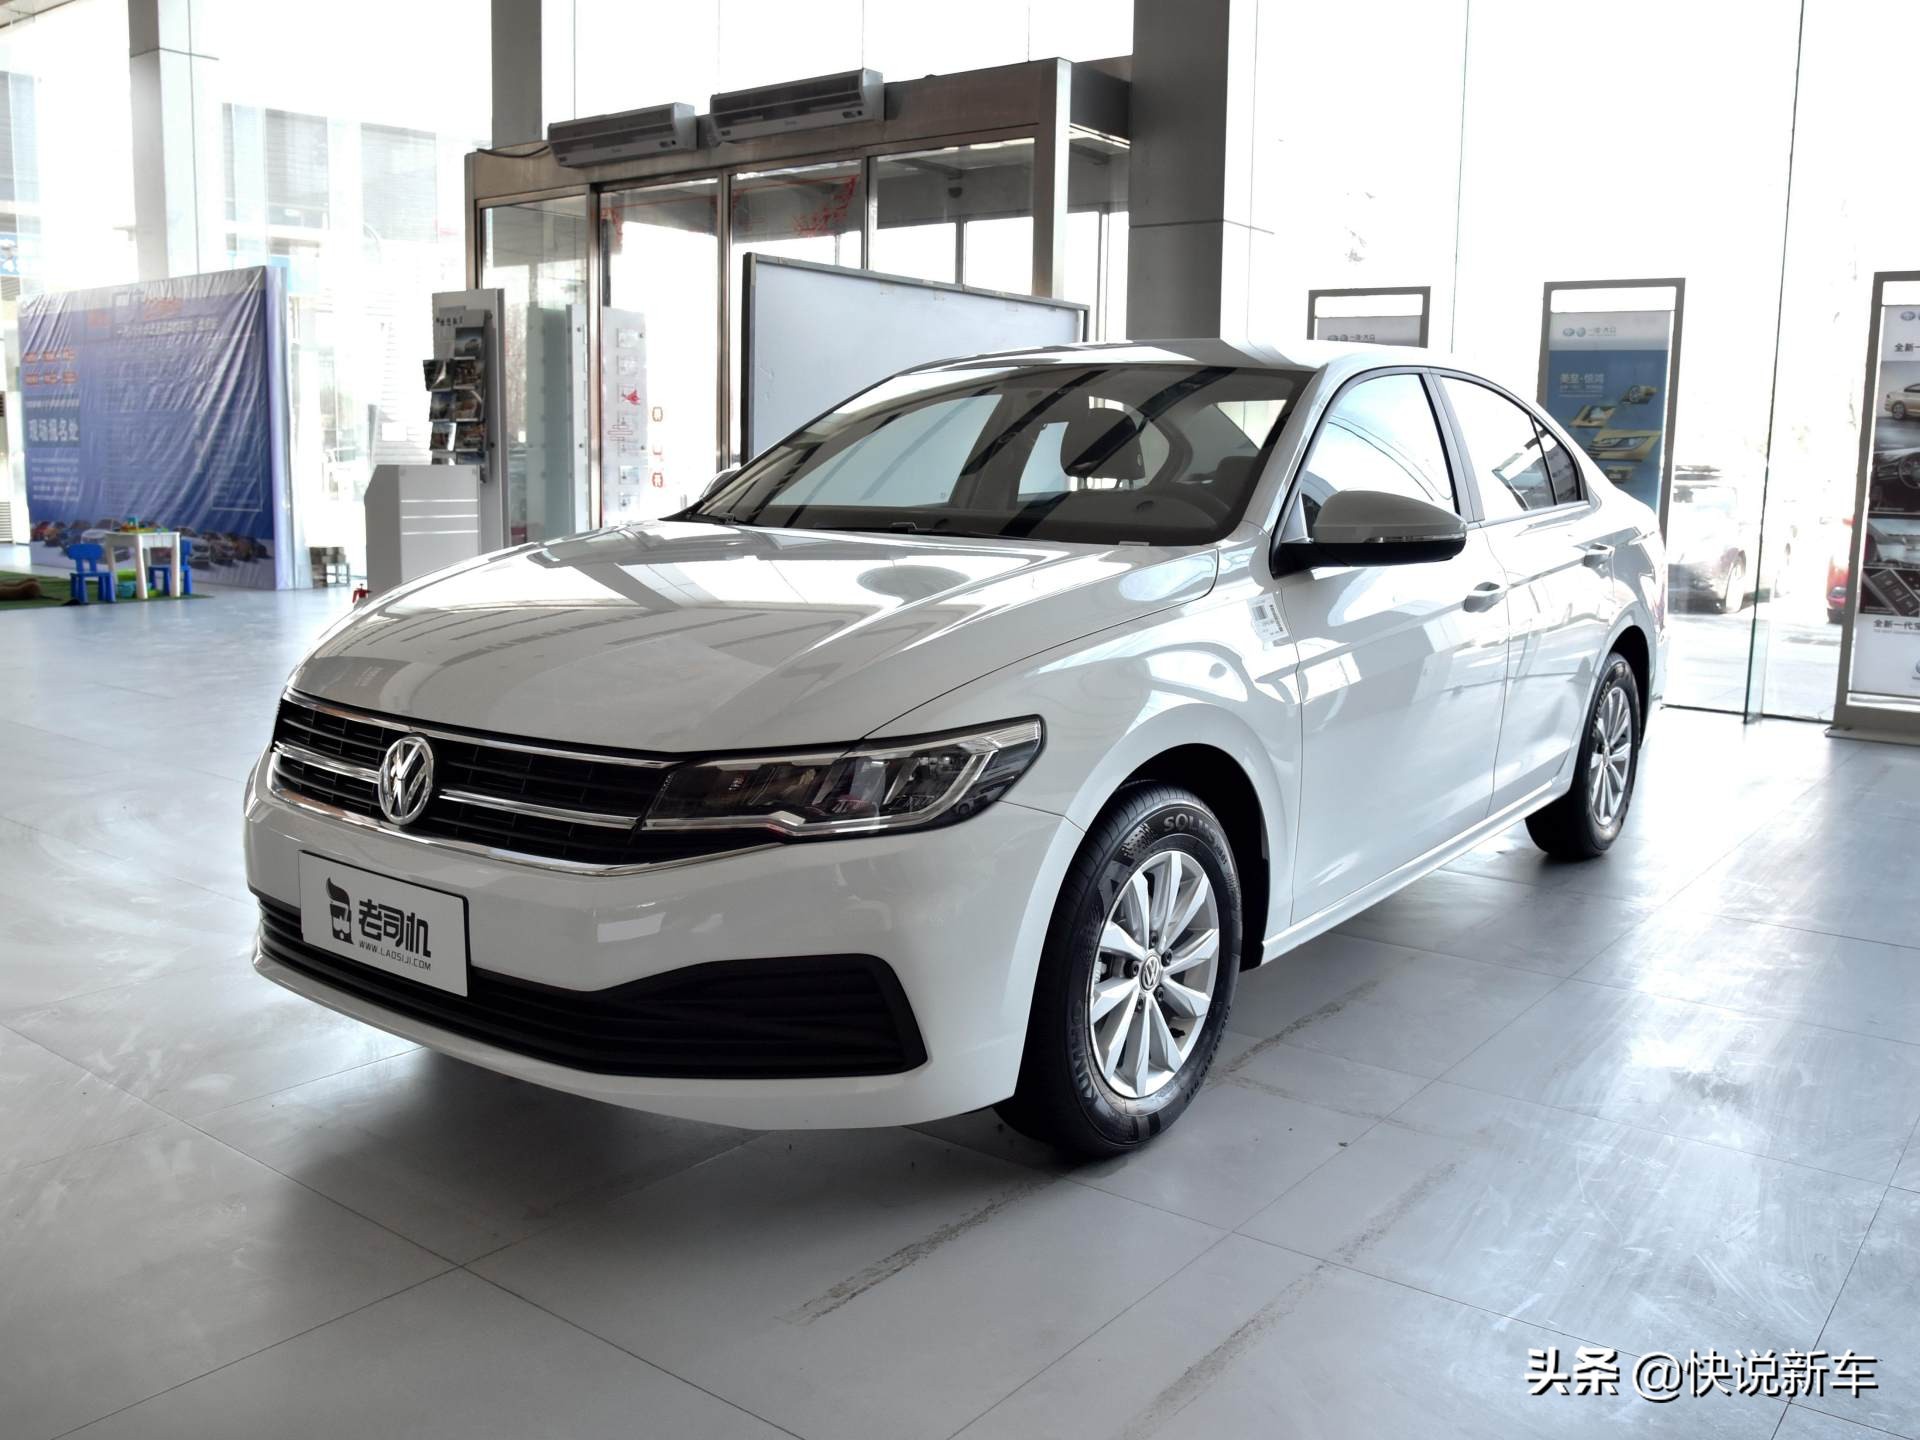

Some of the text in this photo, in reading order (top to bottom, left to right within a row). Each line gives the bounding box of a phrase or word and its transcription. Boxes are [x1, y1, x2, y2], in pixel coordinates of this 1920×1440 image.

[359, 898, 431, 958] 老司机
[358, 940, 432, 971] WWW.LAOSIJI.COM
